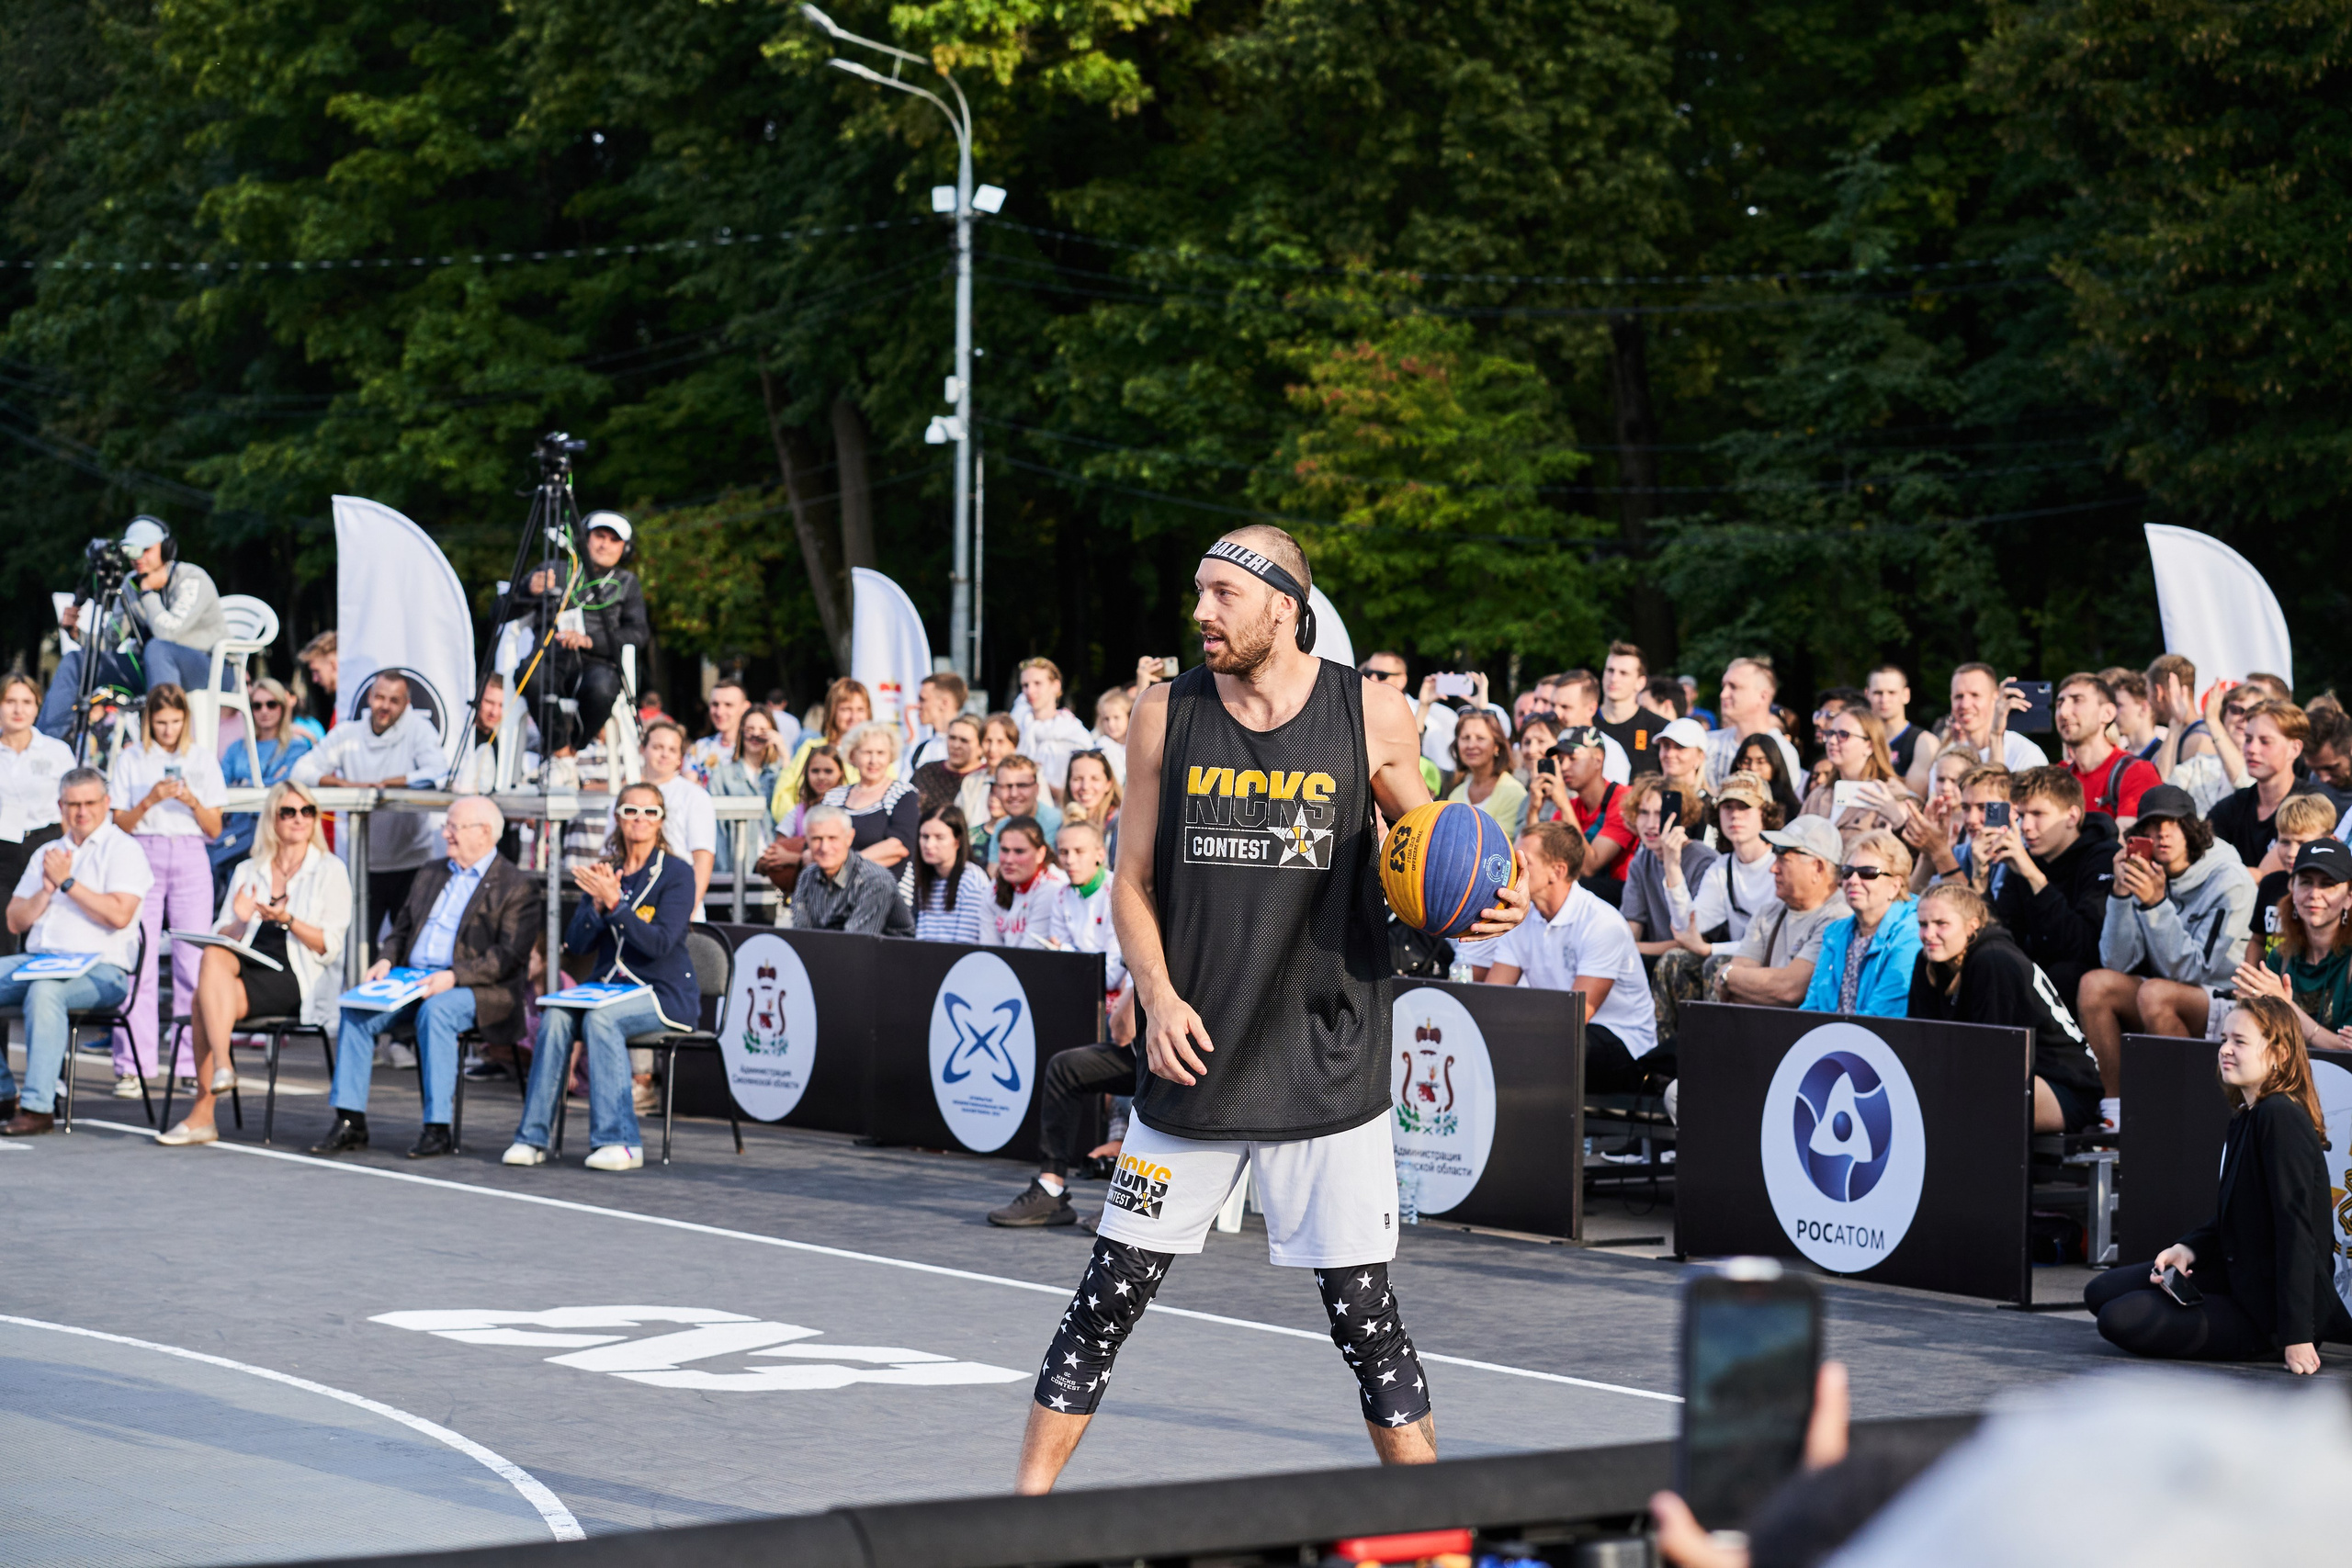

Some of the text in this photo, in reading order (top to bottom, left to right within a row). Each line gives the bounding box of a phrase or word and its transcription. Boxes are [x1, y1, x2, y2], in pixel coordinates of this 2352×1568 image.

[1205, 541, 1274, 575] BALLER!
[1185, 765, 1337, 829] KICKS
[1193, 836, 1271, 861] CONTEST
[1437, 1163, 1473, 1177] области
[1796, 1219, 1885, 1250] РОСАТОМ
[1050, 1376, 1081, 1392] CONTEST
[1057, 1373, 1077, 1386] KICKS
